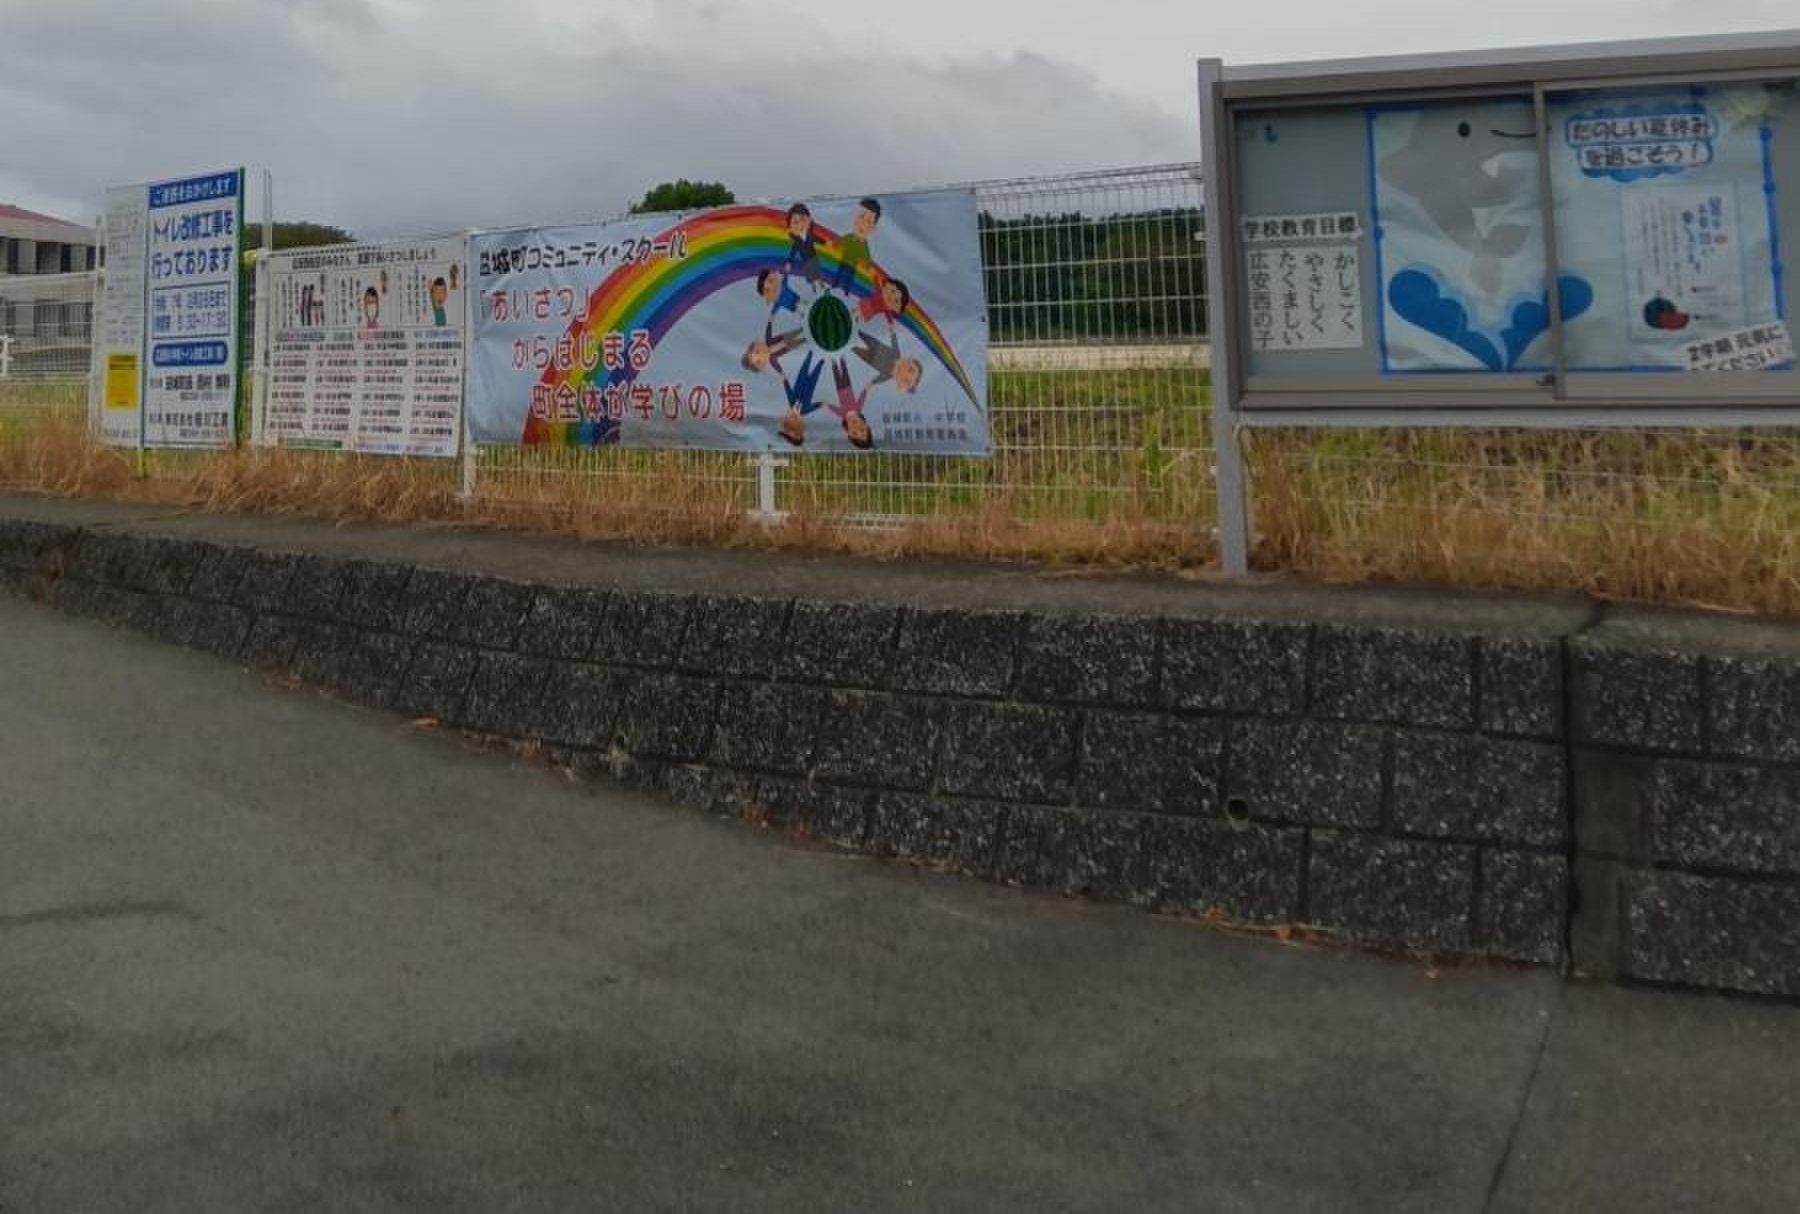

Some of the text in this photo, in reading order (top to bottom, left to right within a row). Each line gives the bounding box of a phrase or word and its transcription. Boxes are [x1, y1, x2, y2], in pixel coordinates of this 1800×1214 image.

[1243, 215, 1357, 239] 学校教育目標
[152, 247, 234, 280] 行っております
[1279, 248, 1304, 347] たくましい
[1304, 251, 1326, 333] やさしく
[1334, 251, 1356, 331] かしこく
[512, 330, 652, 370] からはじまる
[531, 381, 747, 423] 町全体が学びの場
